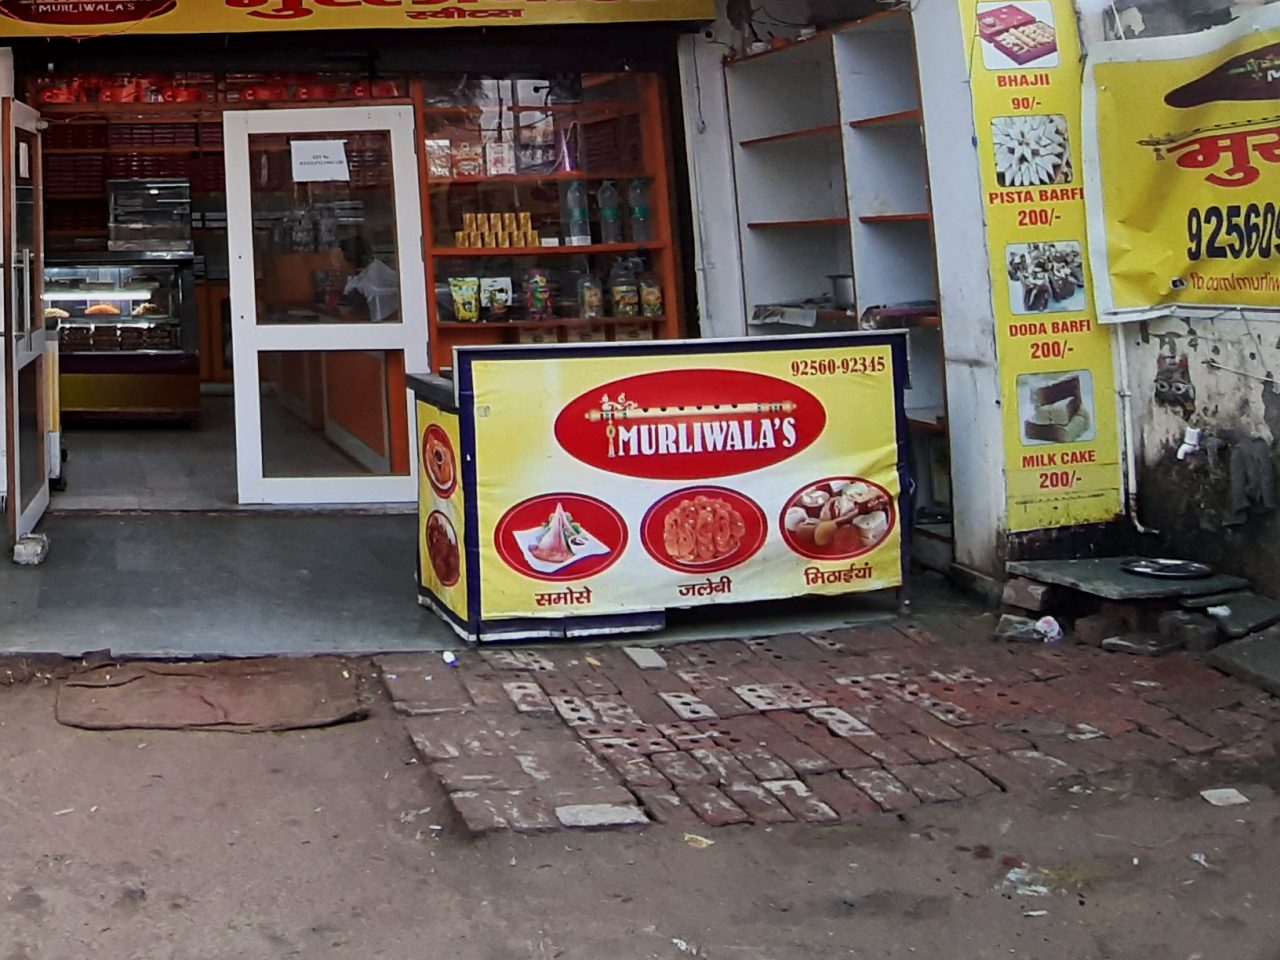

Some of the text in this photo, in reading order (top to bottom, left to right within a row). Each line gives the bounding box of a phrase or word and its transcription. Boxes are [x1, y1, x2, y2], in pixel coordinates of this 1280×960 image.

[38, 1, 135, 15] MURLIWALA'S
[1011, 96, 1041, 110] 90/-
[989, 189, 1034, 205] PISTA
[1017, 209, 1061, 227] 200/-
[1009, 319, 1091, 337] DODA BARFI
[1030, 342, 1074, 359] 200/-
[790, 356, 886, 377] 92560-92345
[617, 417, 797, 457] MURLIWALA'S
[1022, 450, 1096, 468] MILK CAKE
[1039, 471, 1082, 489] 200/-
[803, 562, 873, 587] मिठाईयां
[534, 586, 591, 608] समोसे
